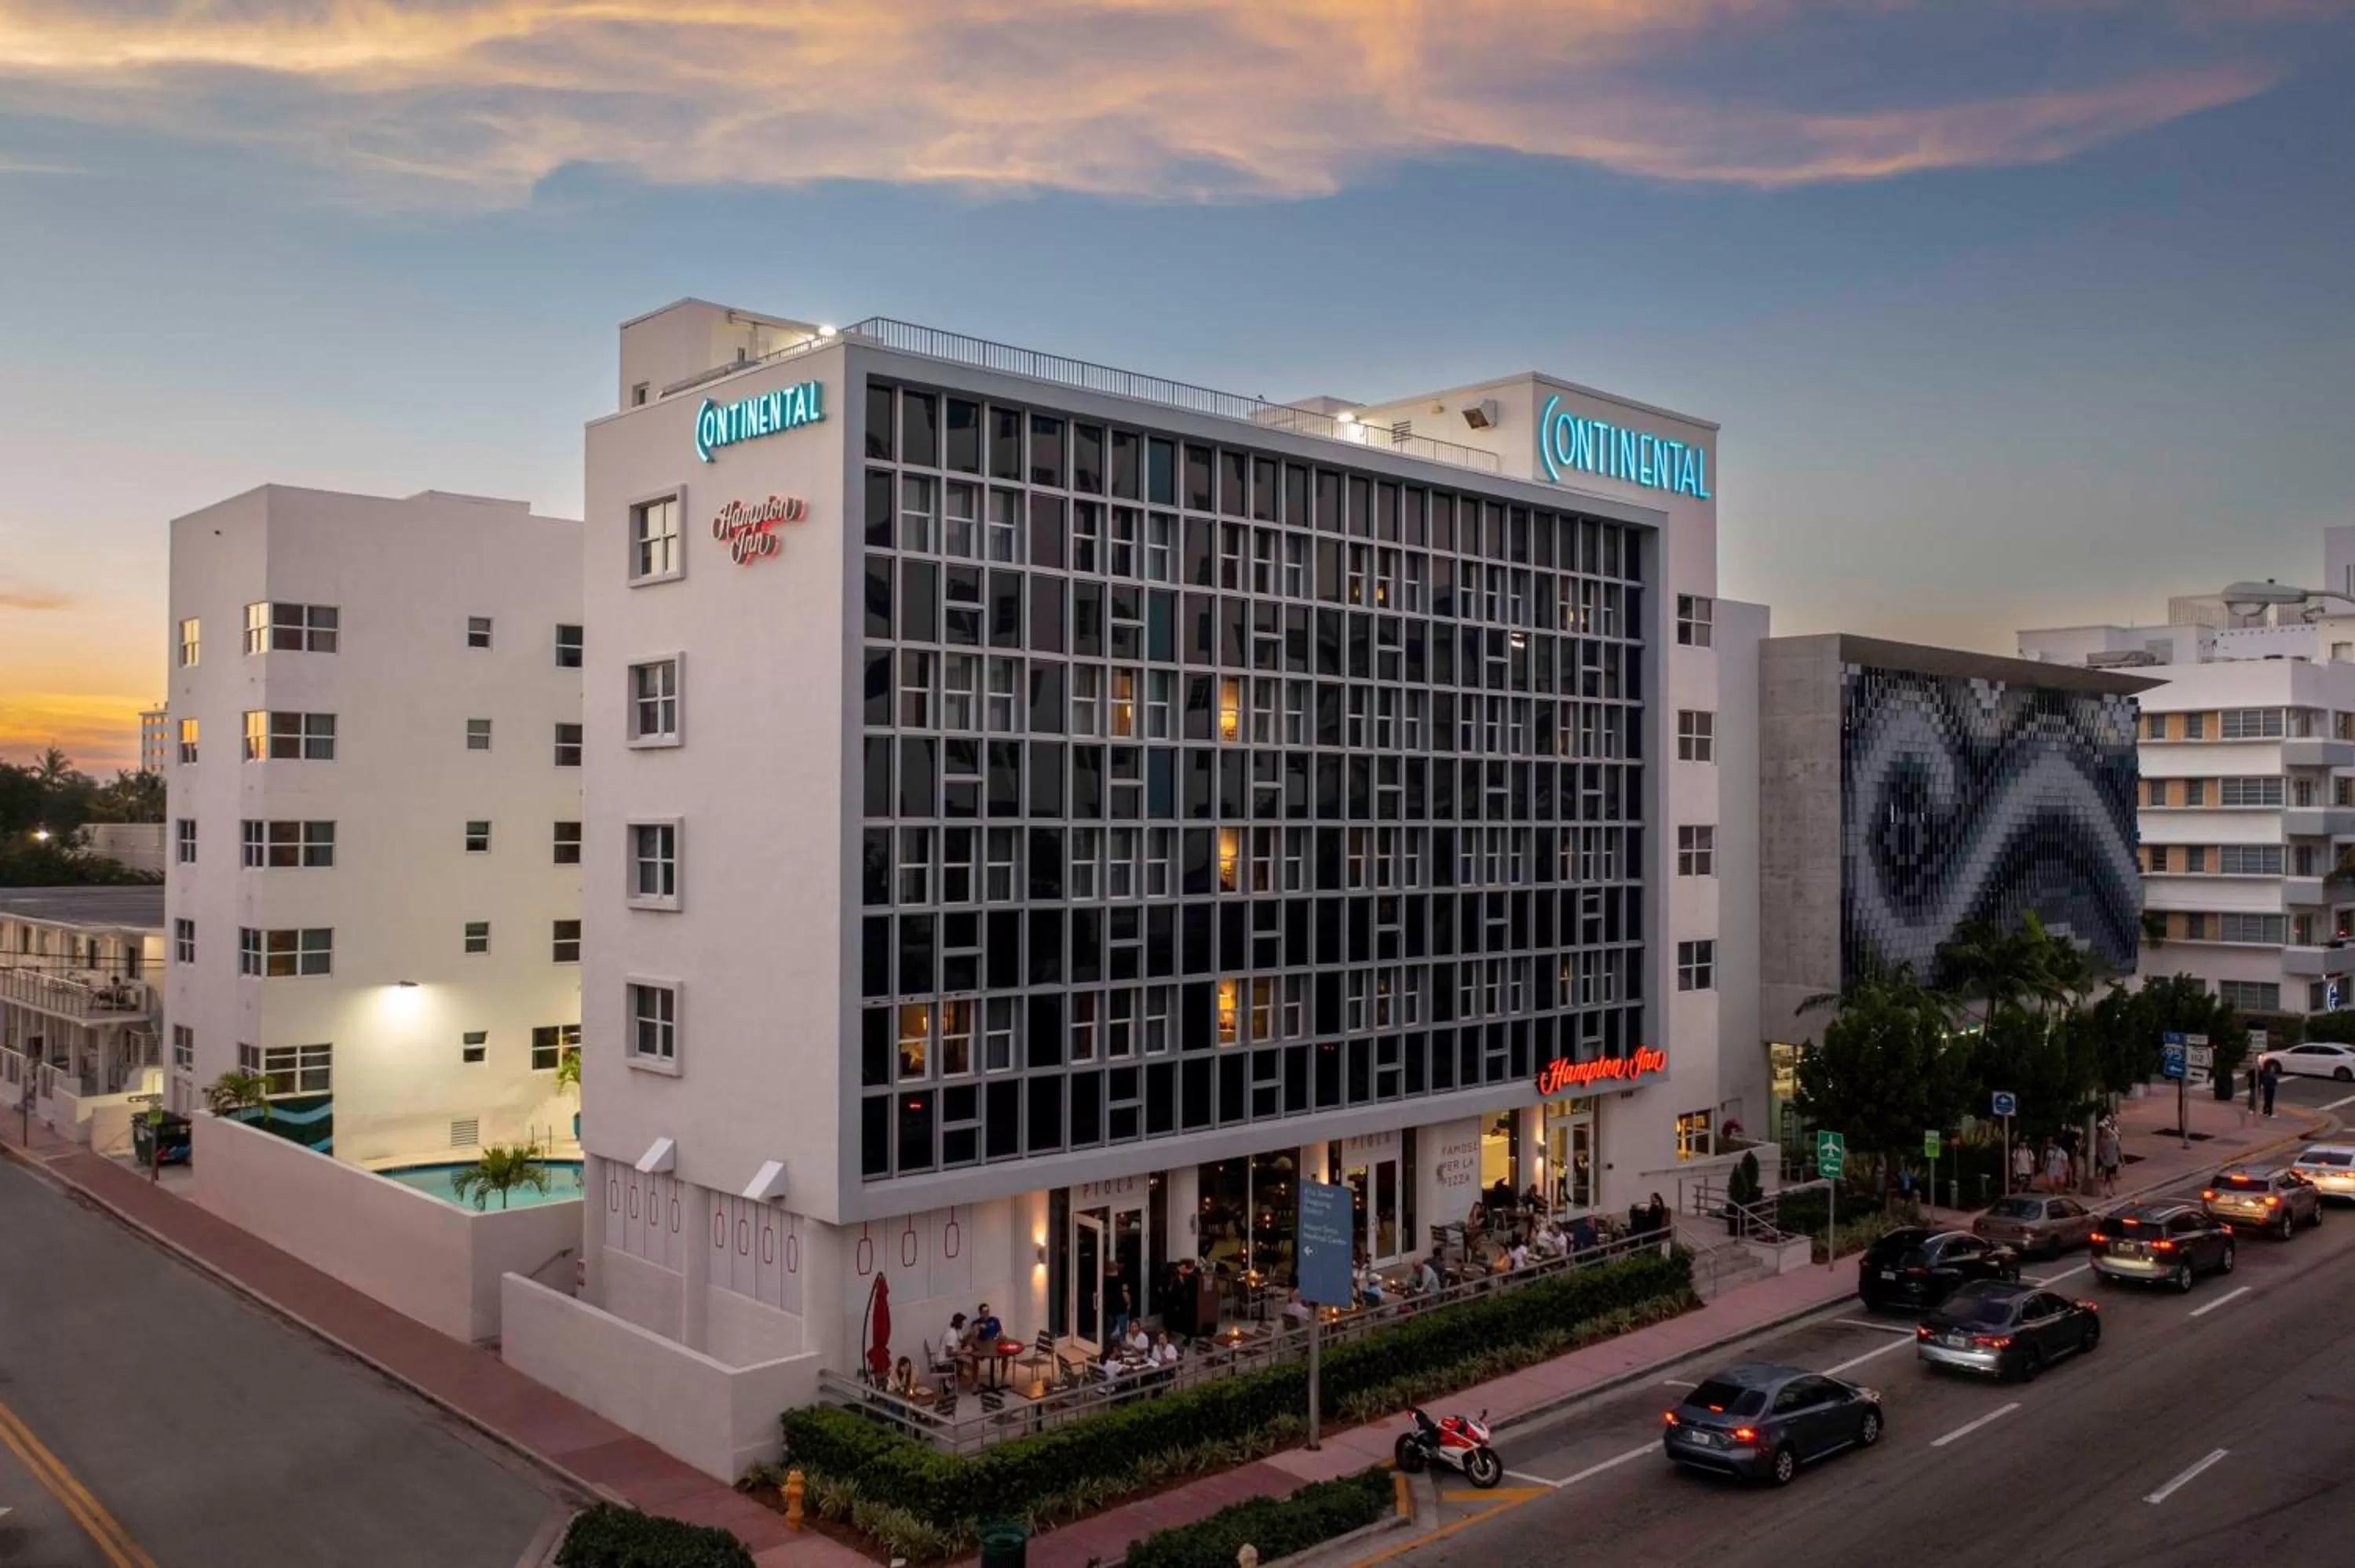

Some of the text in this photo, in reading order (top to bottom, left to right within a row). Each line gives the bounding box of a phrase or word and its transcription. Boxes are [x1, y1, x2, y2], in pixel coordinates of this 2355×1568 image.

[695, 380, 825, 463] CONTINENTAL
[1540, 395, 1712, 499] CONTINENTAL
[711, 495, 804, 541] Hampton
[729, 525, 779, 565] Inn
[1539, 1045, 1667, 1096] Hampton Inn
[2166, 1048, 2182, 1061] 95
